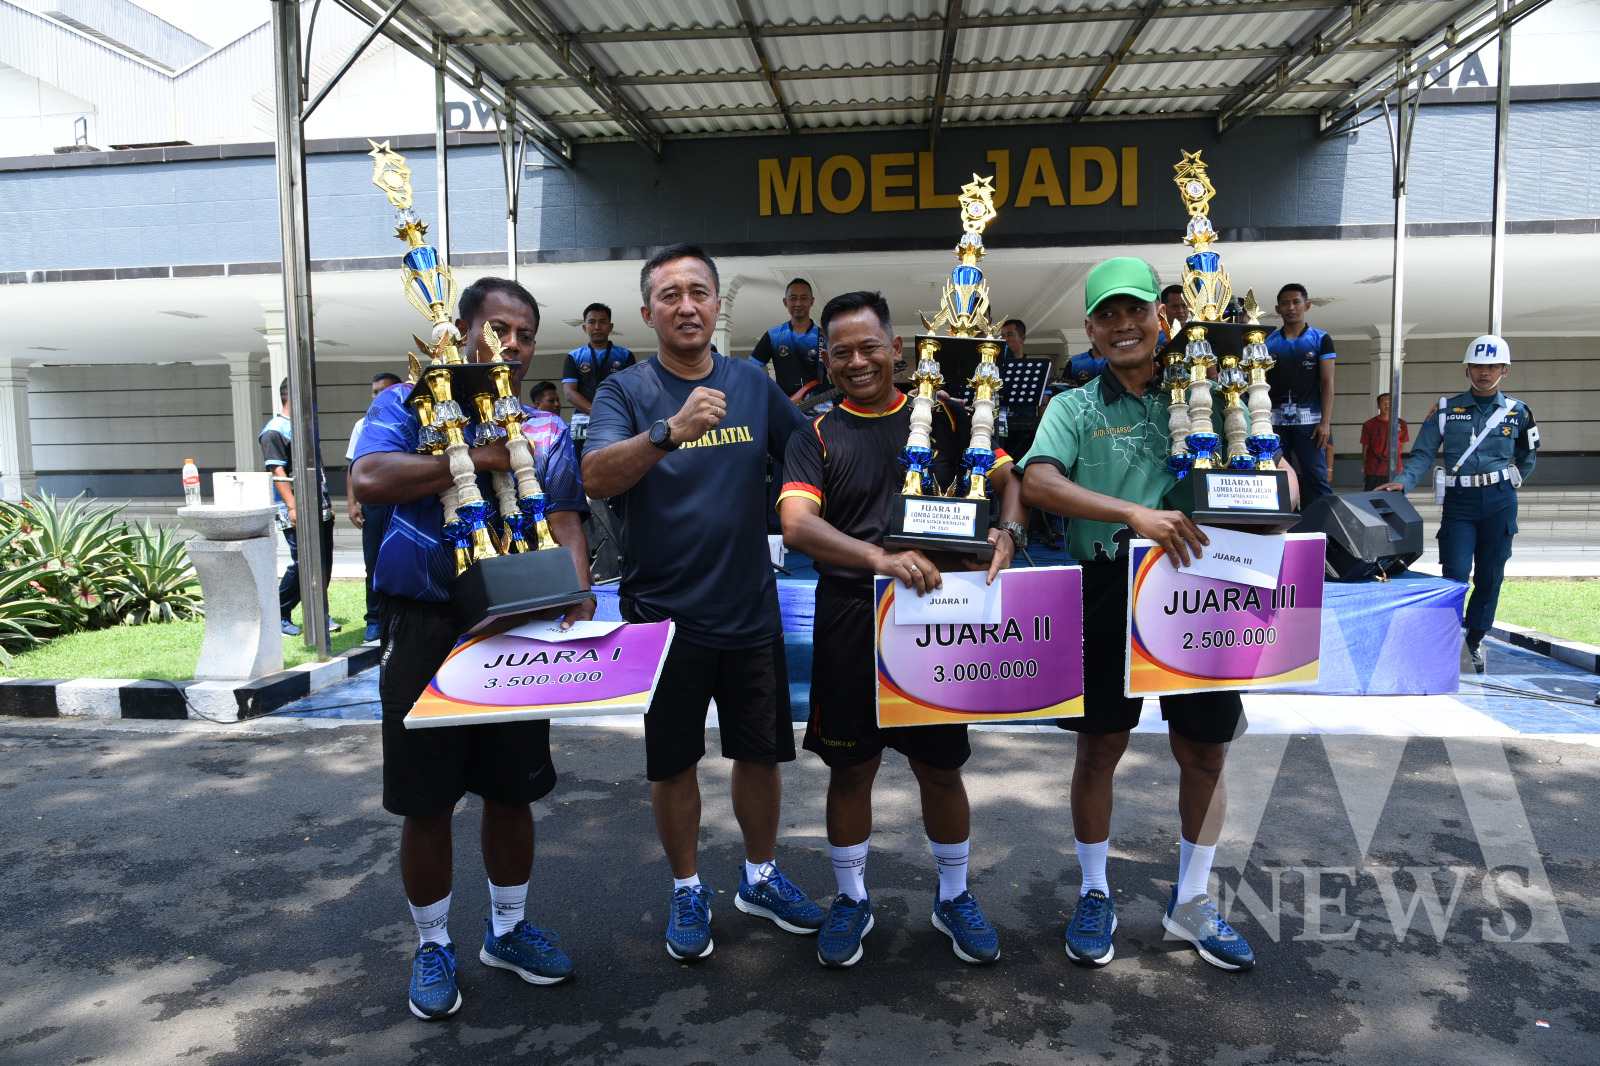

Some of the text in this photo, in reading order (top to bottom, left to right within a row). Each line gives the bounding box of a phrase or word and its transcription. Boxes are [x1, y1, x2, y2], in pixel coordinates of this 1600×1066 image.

[1474, 344, 1498, 358] PM
[1220, 478, 1250, 487] JUARA
[921, 504, 951, 514] JUARA
[1212, 551, 1253, 566] JUARA III
[1163, 584, 1297, 616] JUARA III
[915, 615, 1053, 648] JUARA II
[1182, 627, 1277, 650] 2.500.000
[483, 647, 622, 669] JUARA I
[483, 671, 602, 689] 3.500.000
[933, 659, 1039, 683] 3.000.000
